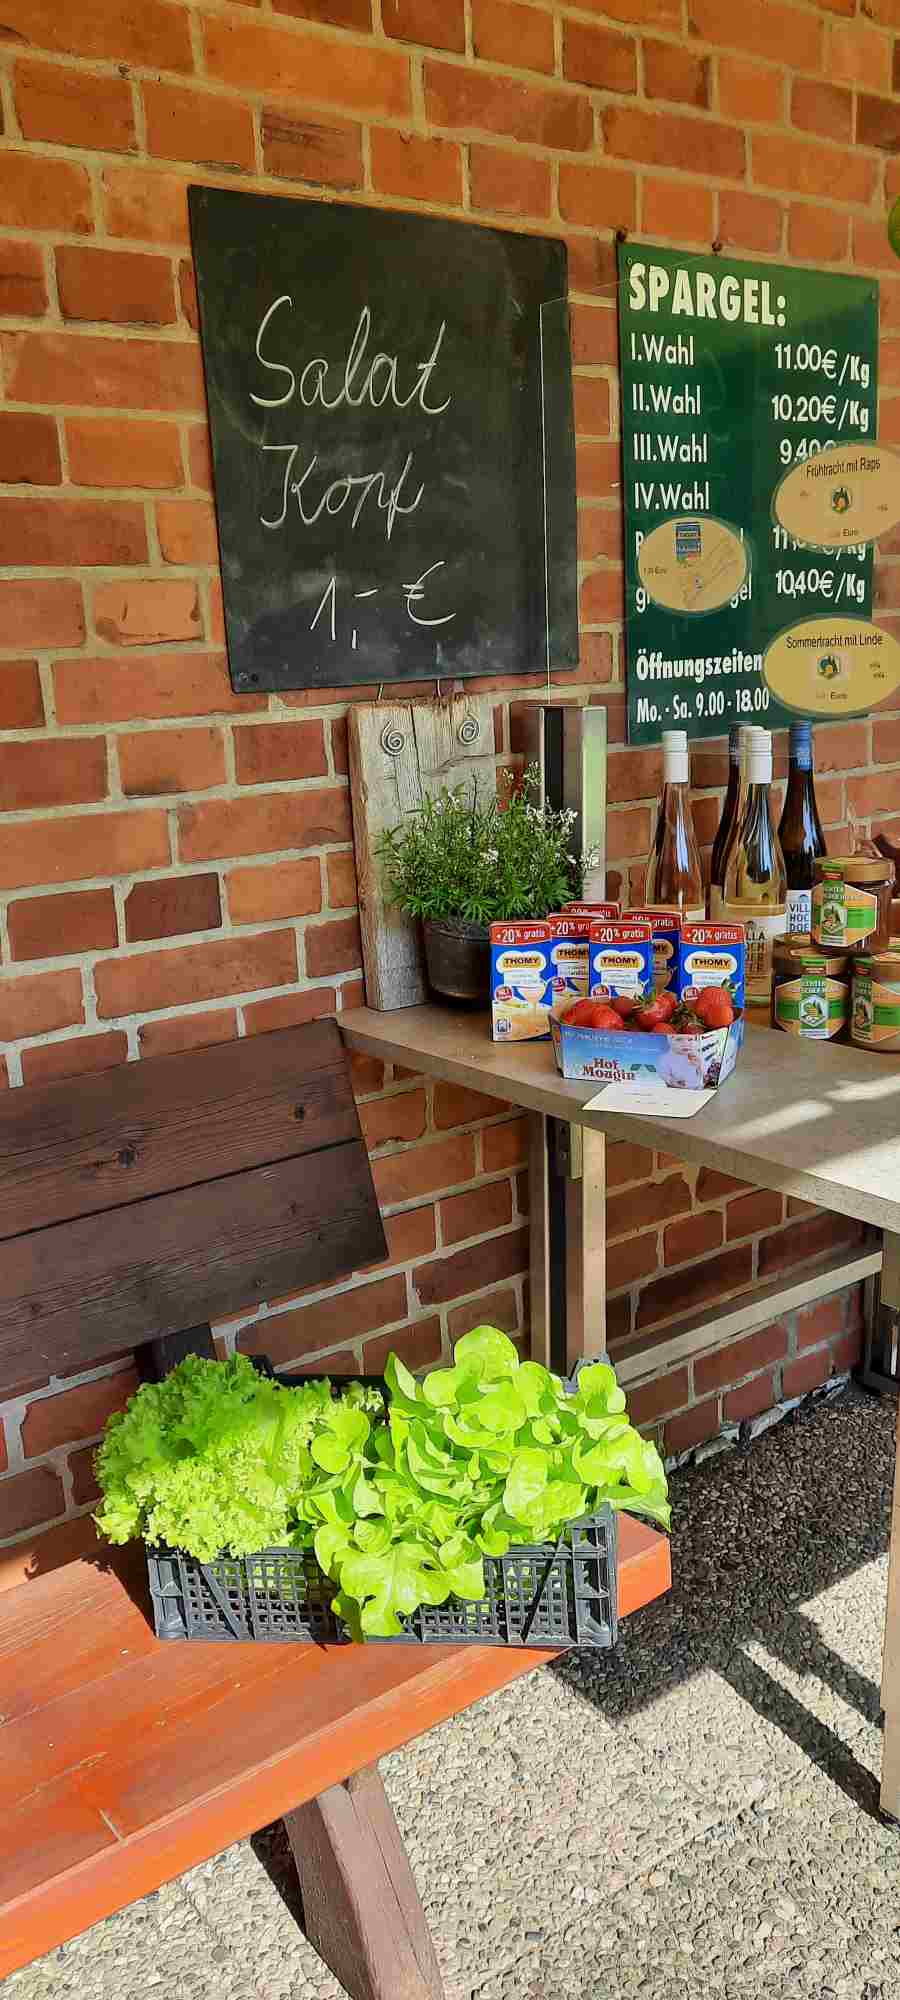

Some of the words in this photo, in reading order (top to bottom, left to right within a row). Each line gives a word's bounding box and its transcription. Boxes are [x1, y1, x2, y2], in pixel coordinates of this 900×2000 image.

[629, 262, 786, 327] SPARGEL:
[249, 295, 452, 414] Salat
[631, 333, 695, 366] I.Wahl
[632, 383, 701, 416] II.Wahl
[633, 433, 708, 463] III.Wahl
[846, 458, 858, 473] mit
[634, 478, 710, 510] IV.Wahl
[402, 561, 456, 626] €
[844, 632, 858, 647] mit
[637, 698, 662, 723] Mo.
[673, 694, 692, 720] Sa.
[696, 690, 725, 717] 9.00
[735, 686, 769, 712] 18.00
[504, 957, 540, 965] THOMY
[602, 956, 638, 965] THOMY
[694, 958, 730, 966] THOMY
[593, 1057, 620, 1070] Hof
